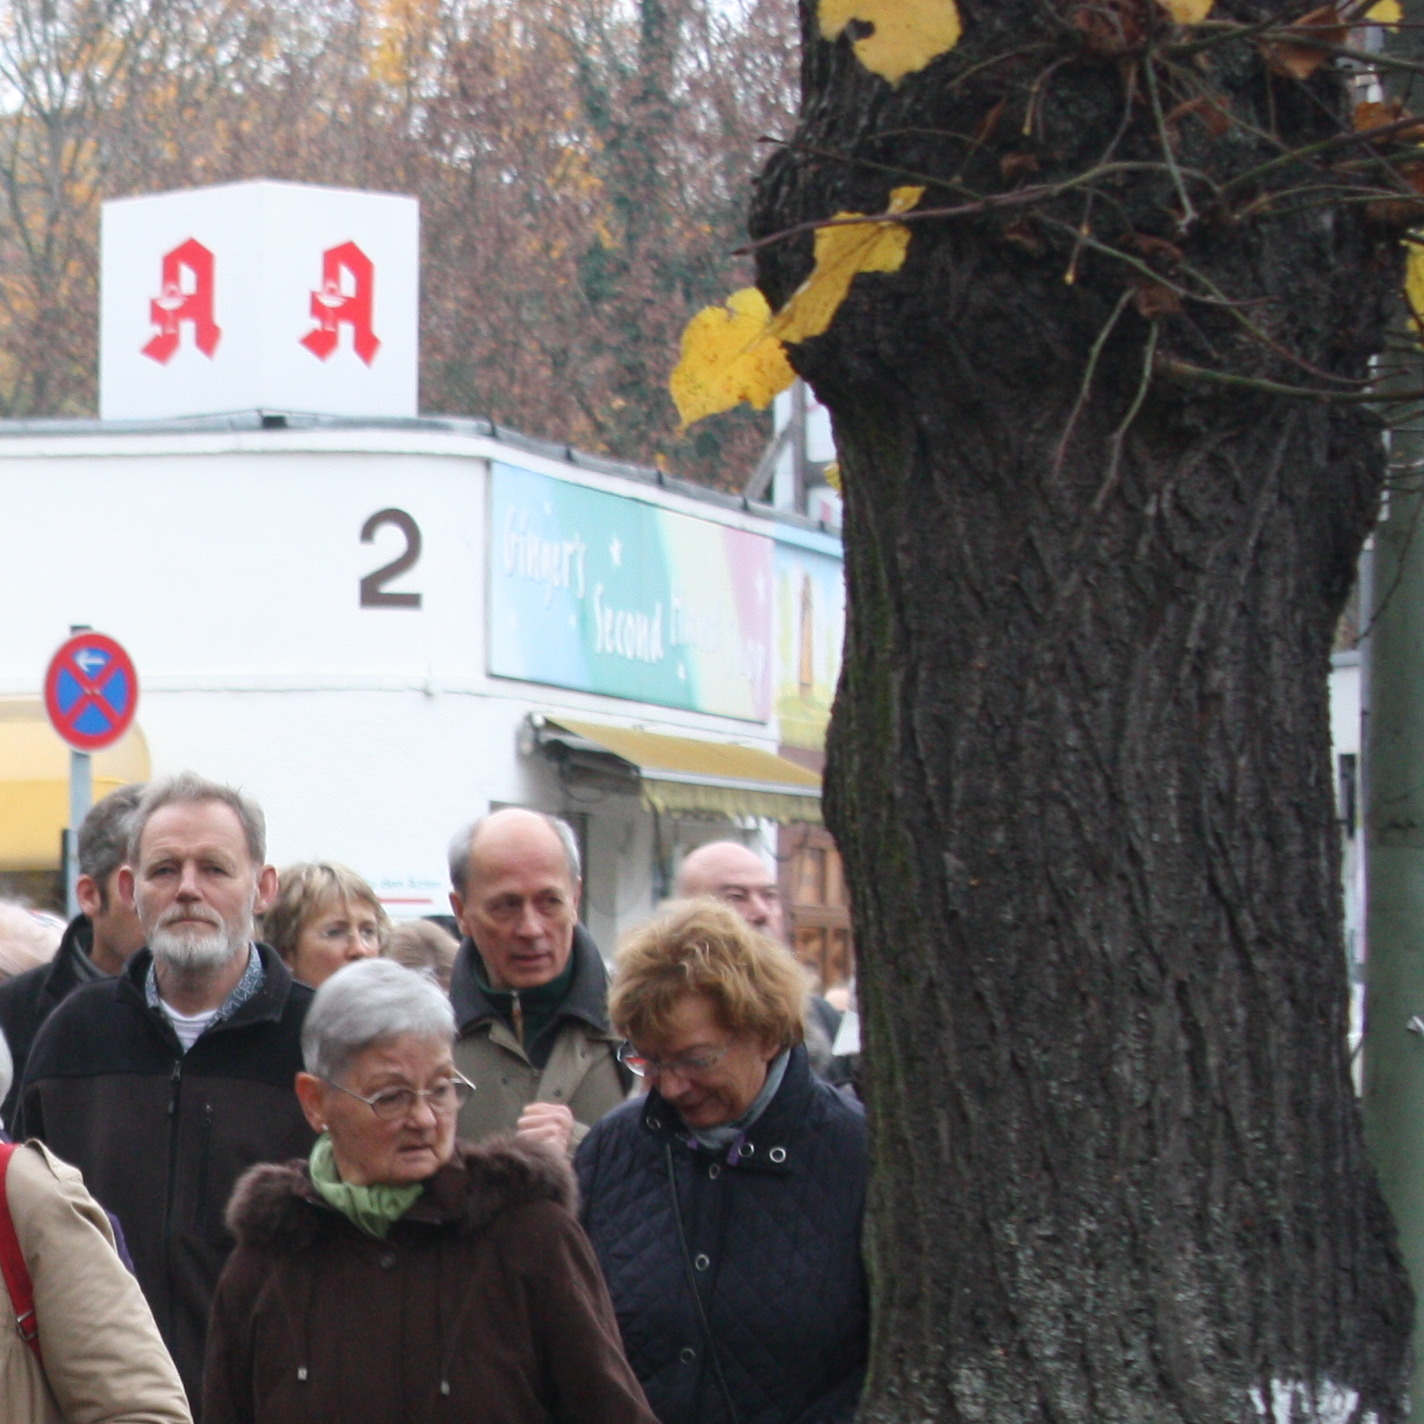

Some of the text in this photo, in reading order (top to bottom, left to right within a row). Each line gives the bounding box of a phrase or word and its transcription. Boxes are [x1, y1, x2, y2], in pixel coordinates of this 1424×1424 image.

[140, 237, 222, 366] A
[299, 240, 381, 368] A
[359, 507, 423, 609] 2
[594, 583, 665, 664] Second
